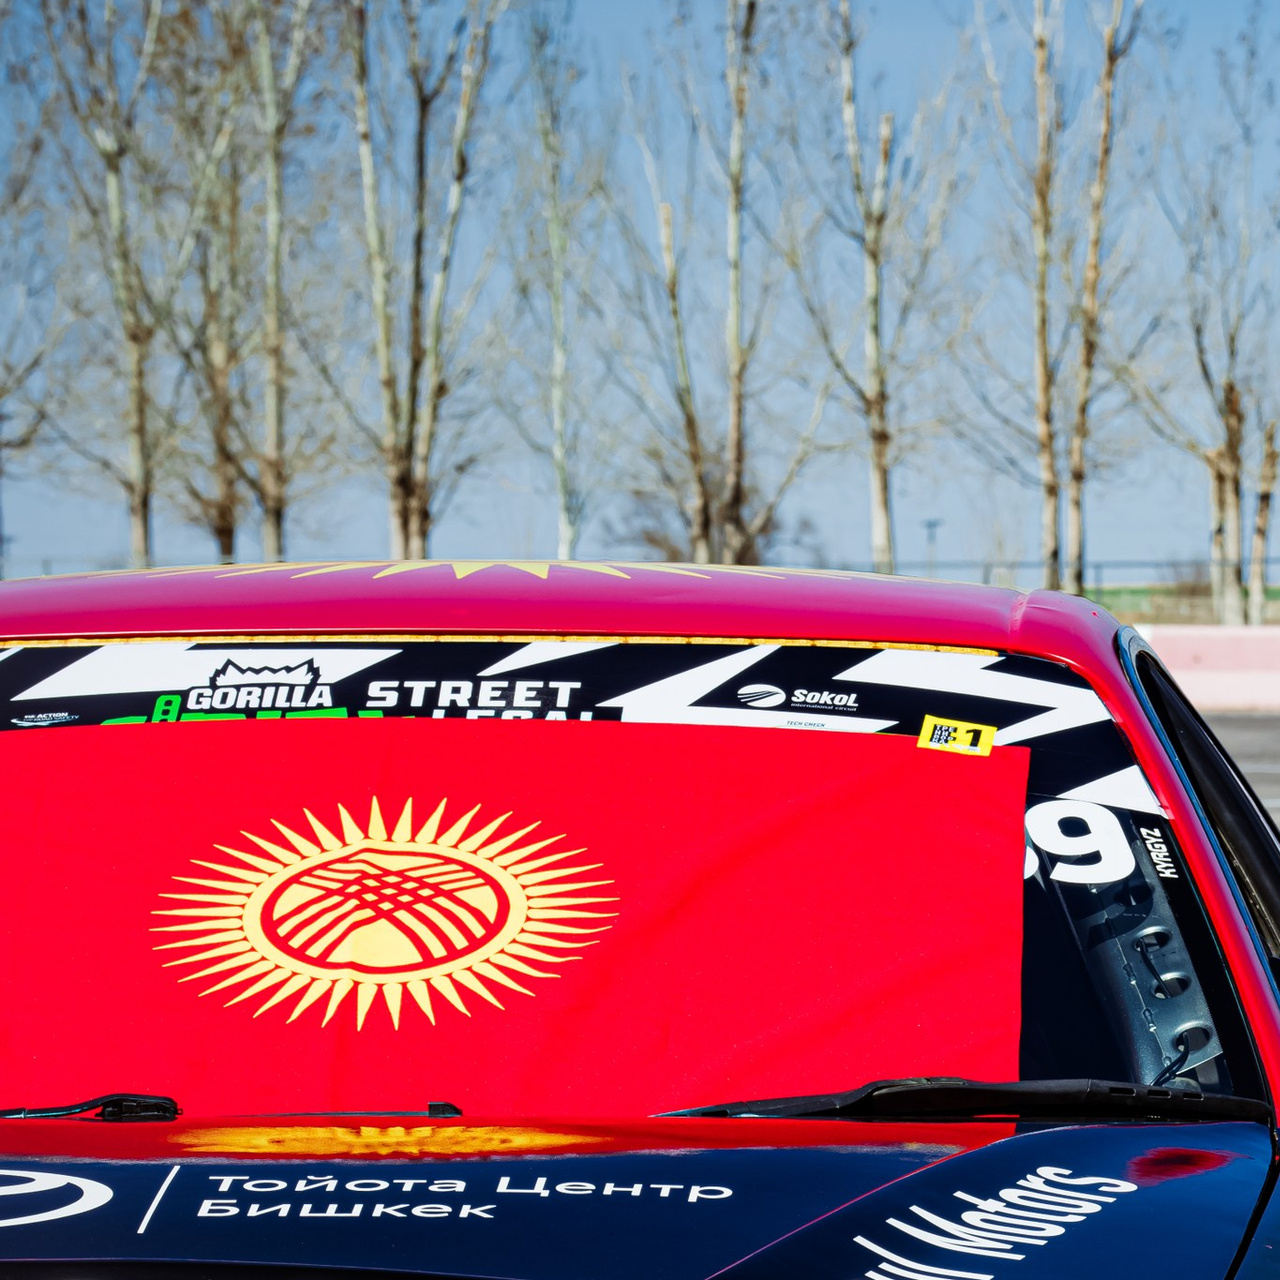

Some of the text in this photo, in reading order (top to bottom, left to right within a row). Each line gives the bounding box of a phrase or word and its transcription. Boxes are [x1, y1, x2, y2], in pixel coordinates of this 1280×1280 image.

[187, 680, 582, 710] GORILLA STREET
[965, 728, 983, 747] 1
[1139, 827, 1179, 879] KYRGYZ
[208, 1175, 734, 1202] Тойота Центр
[197, 1199, 498, 1218] Бишкек
[886, 1166, 1139, 1260] Motors
